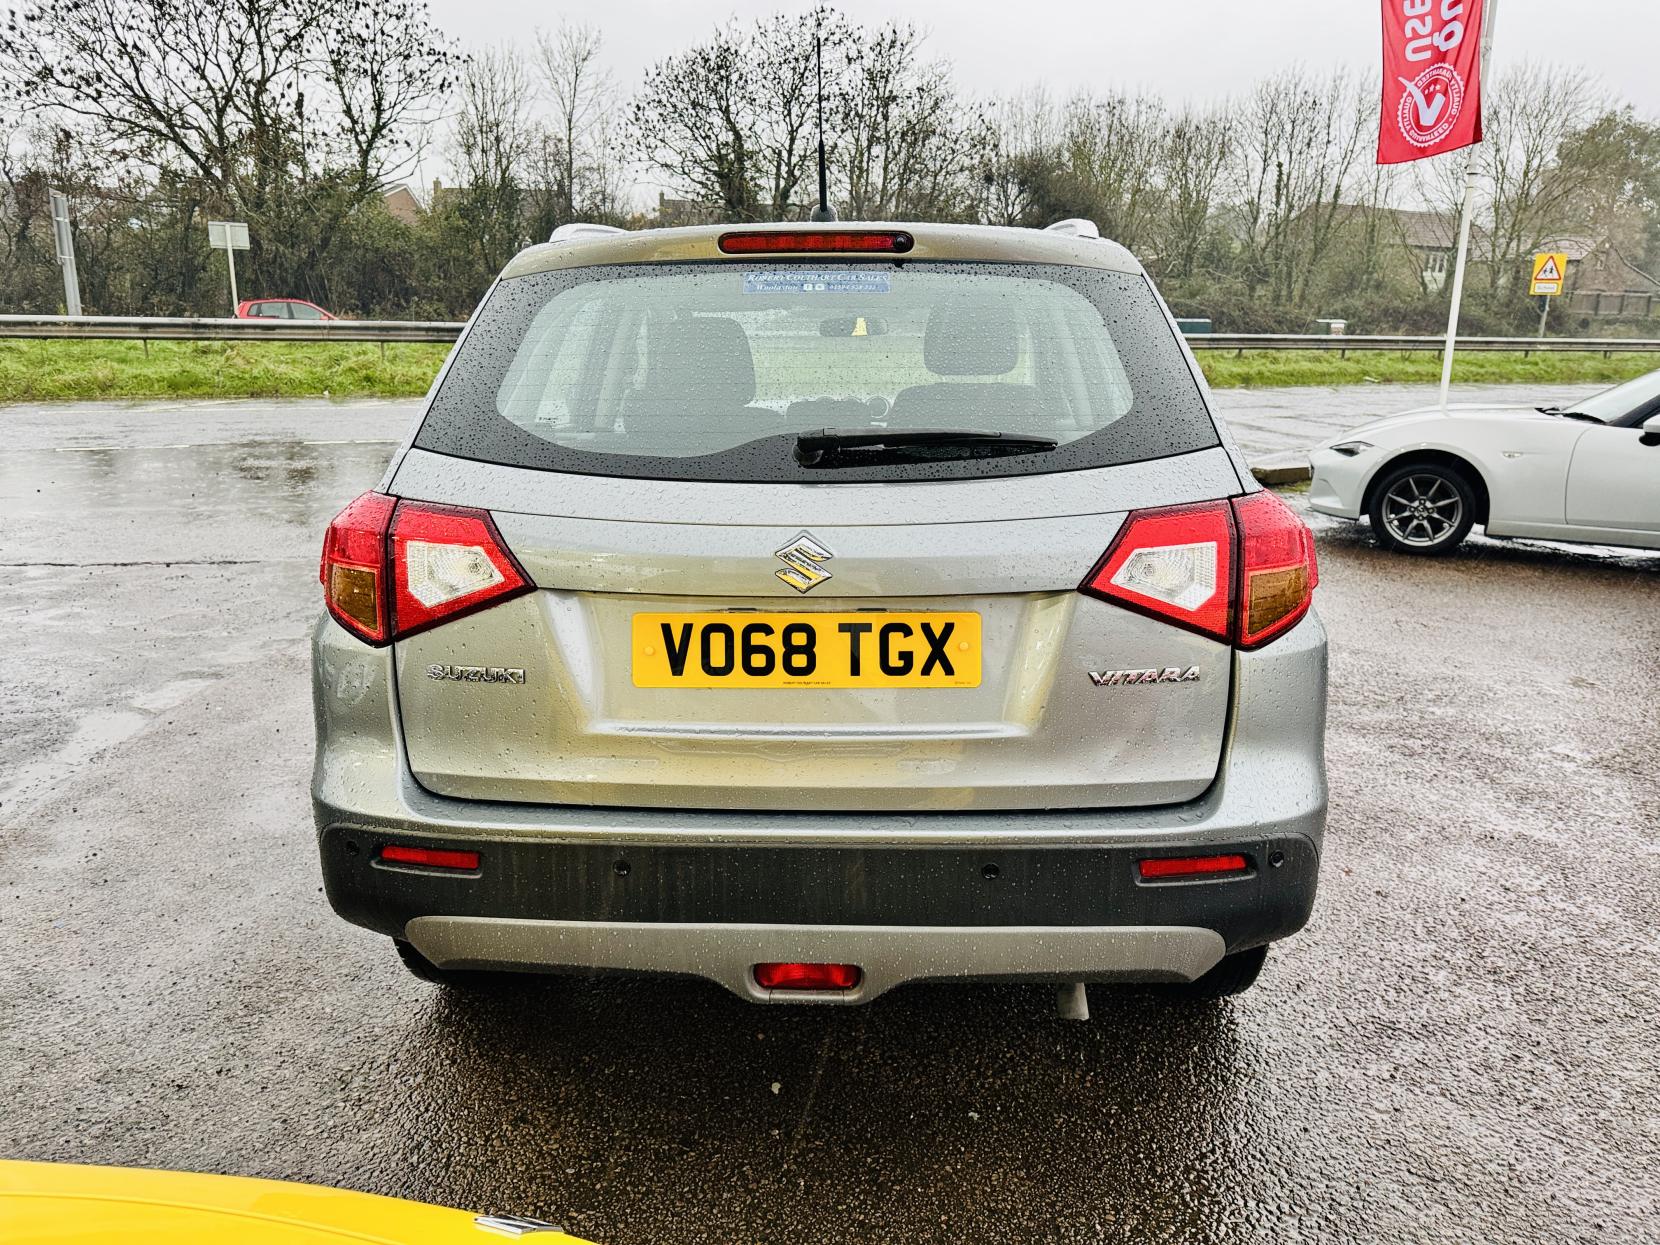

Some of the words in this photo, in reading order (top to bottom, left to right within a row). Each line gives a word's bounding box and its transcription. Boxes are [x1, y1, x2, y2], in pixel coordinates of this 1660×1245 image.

[661, 622, 817, 677] VO68
[838, 622, 956, 677] TGX
[426, 663, 526, 684] SUZUKI
[1088, 665, 1201, 686] VITARA
